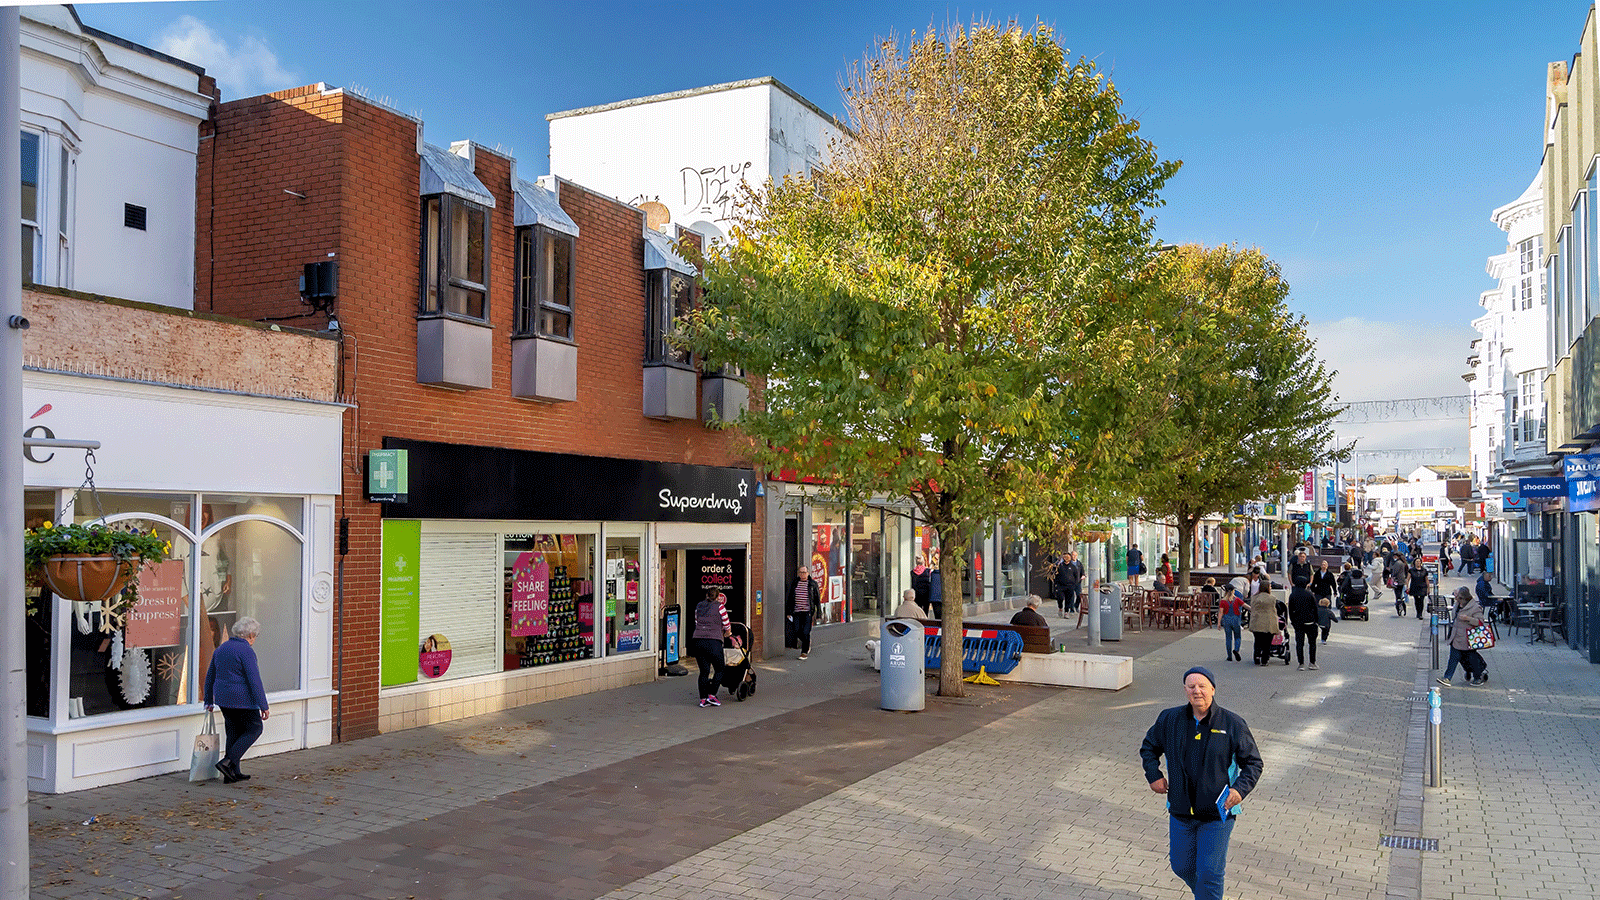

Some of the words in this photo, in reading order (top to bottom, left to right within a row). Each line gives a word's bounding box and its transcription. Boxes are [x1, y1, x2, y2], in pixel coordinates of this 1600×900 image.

[1523, 483, 1561, 491] shoezone
[658, 488, 742, 515] Superdrug
[701, 564, 725, 573] order
[726, 564, 733, 573] &
[701, 574, 732, 585] collect
[517, 580, 545, 592] SHARE
[166, 596, 177, 605] to
[513, 599, 547, 612] FEELING
[131, 607, 179, 623] impress!
